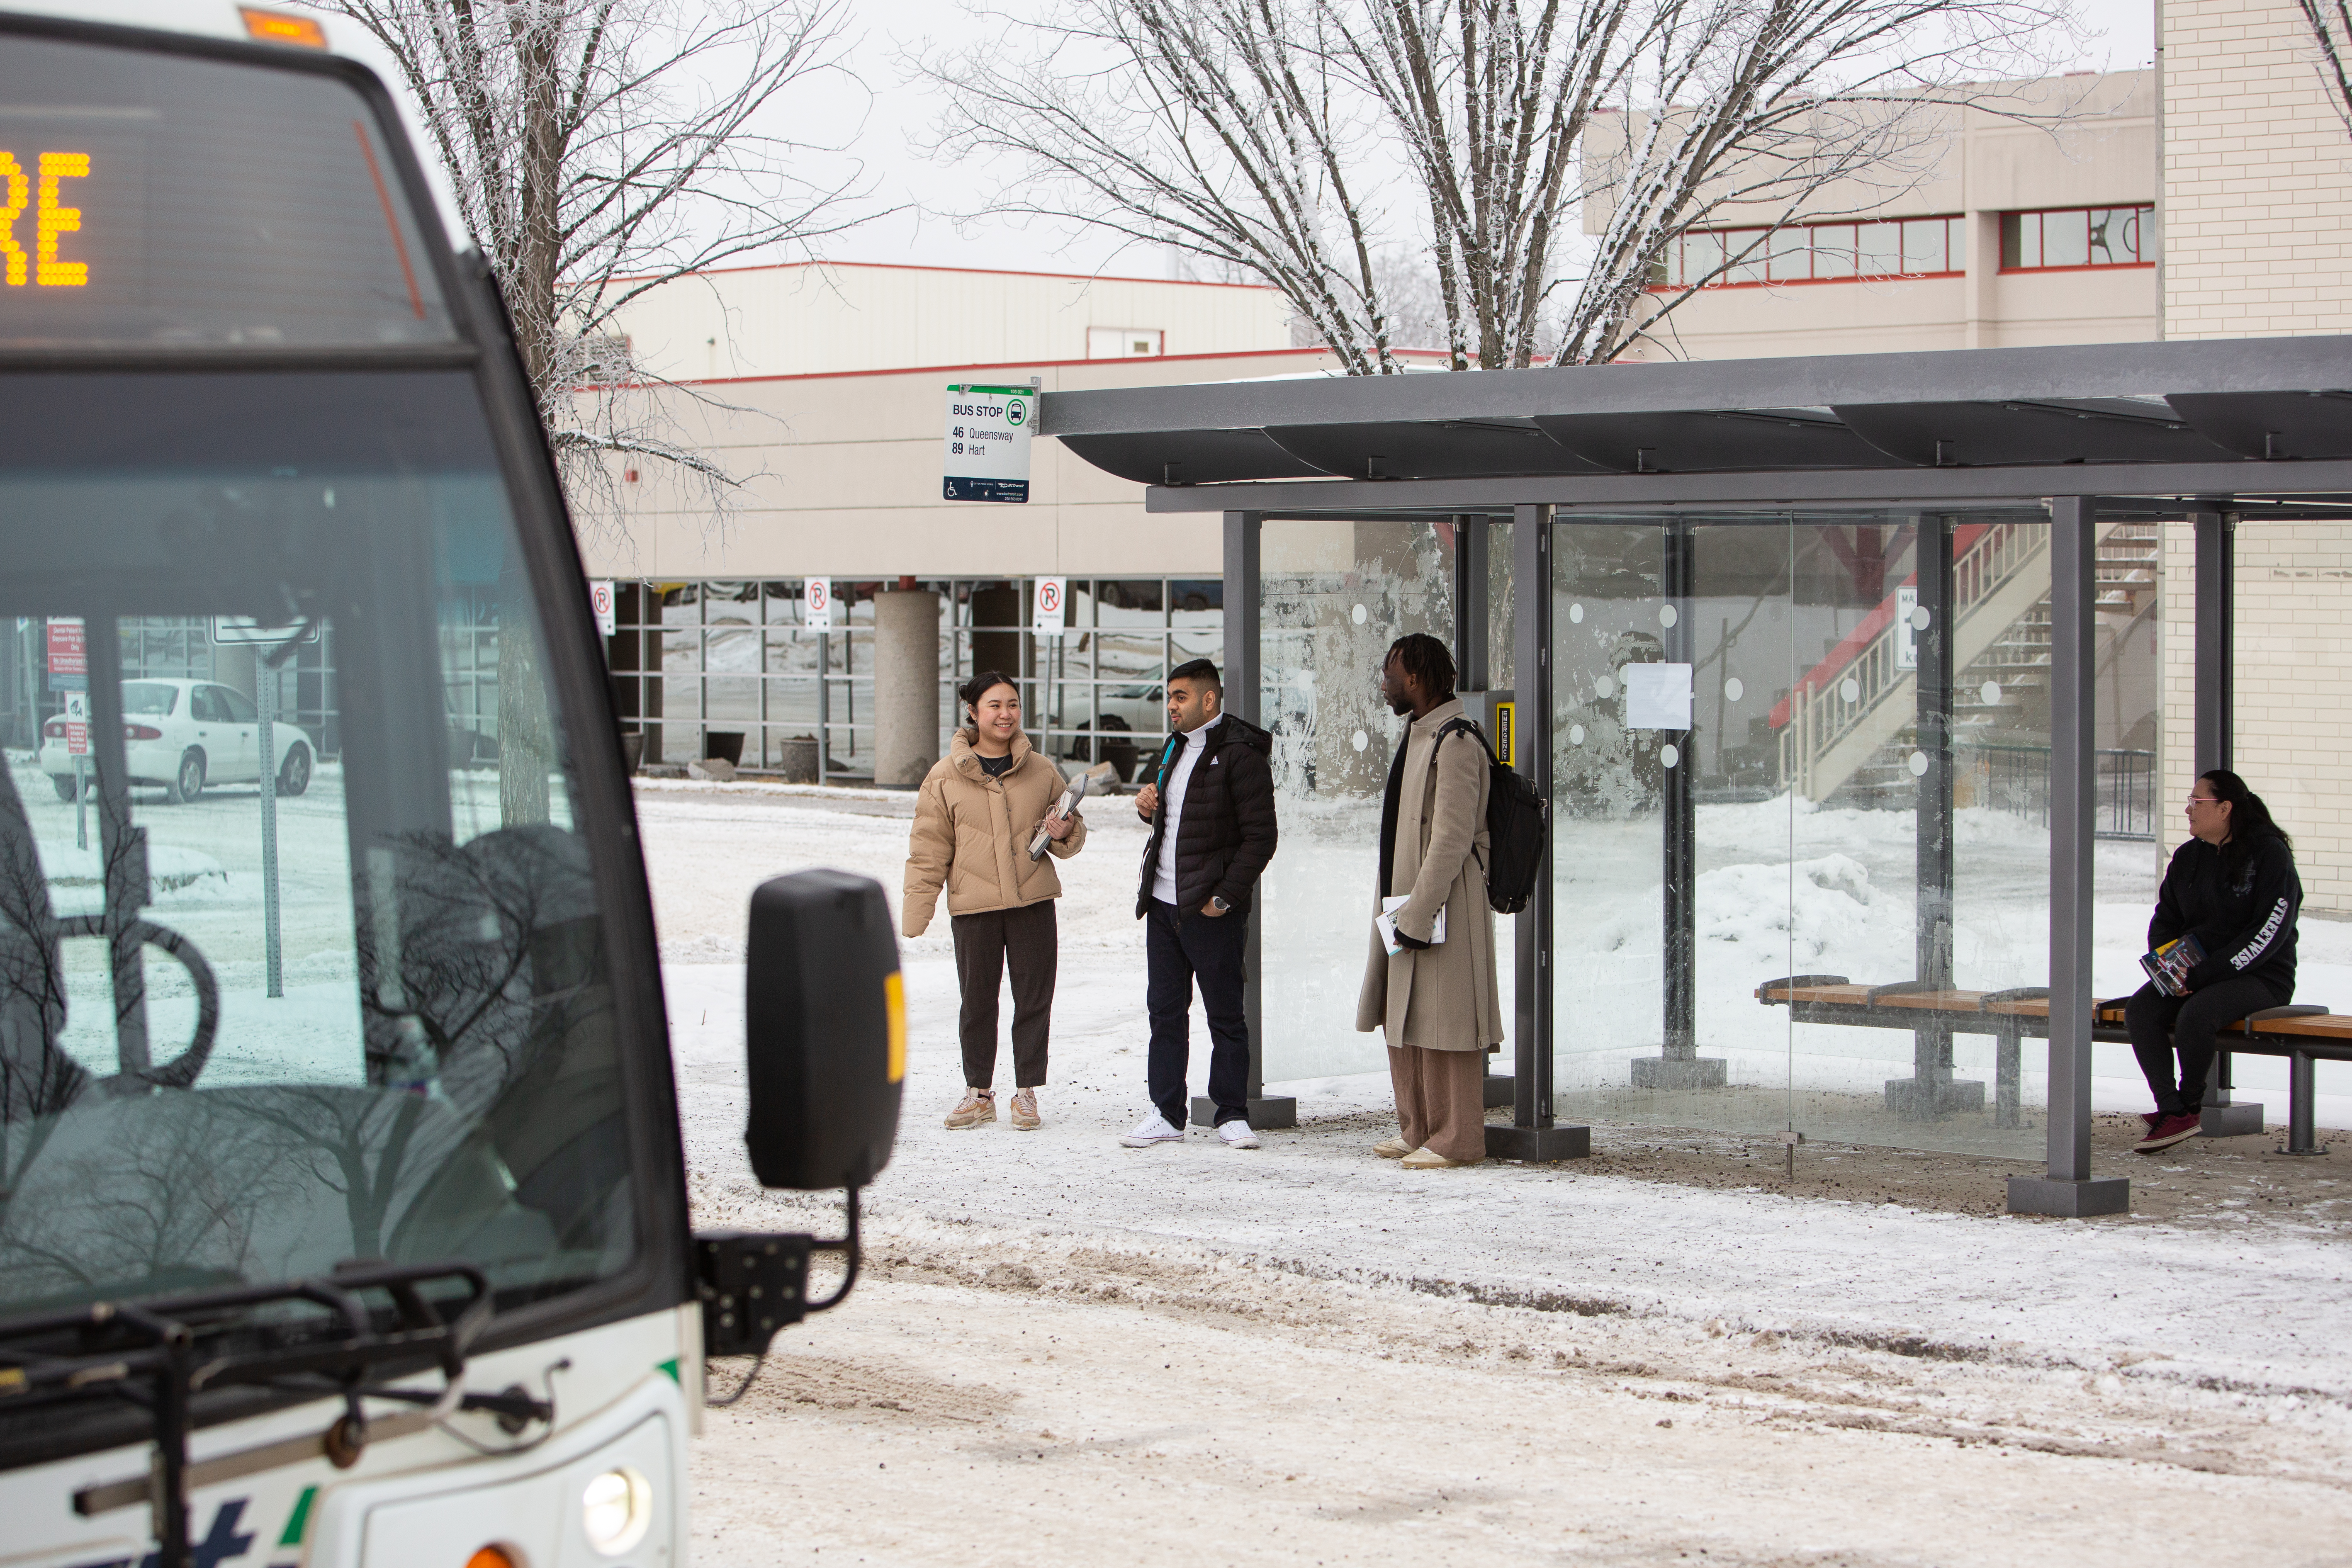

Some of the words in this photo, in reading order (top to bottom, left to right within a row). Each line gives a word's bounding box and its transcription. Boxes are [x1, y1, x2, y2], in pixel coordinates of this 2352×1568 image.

[953, 404, 974, 416] BUS
[976, 406, 1003, 417] STOP
[953, 426, 964, 438] 46
[969, 428, 1013, 443] Queensway
[952, 442, 963, 454] 89
[969, 444, 985, 455] Hart
[2230, 897, 2289, 971] STREETWISE
